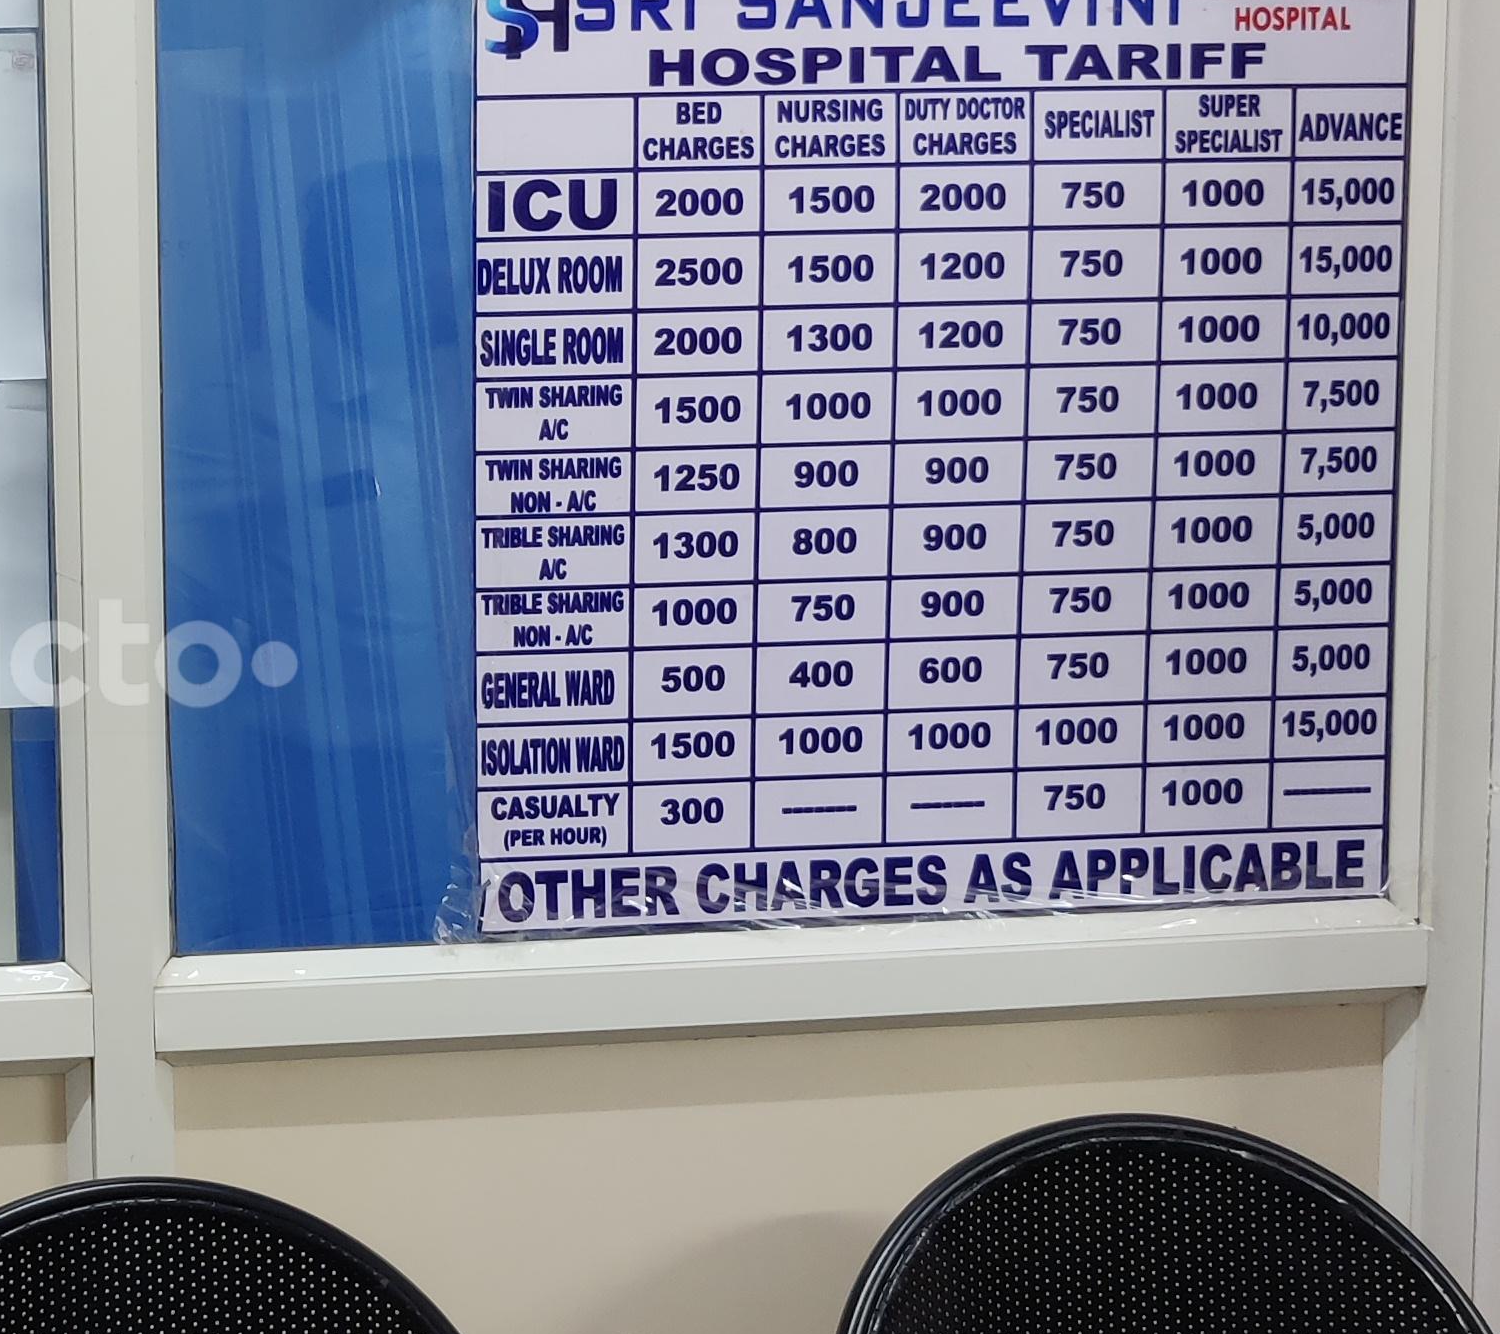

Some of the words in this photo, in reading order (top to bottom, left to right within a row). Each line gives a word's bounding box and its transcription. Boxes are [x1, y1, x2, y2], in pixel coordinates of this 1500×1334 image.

[1235, 7, 1350, 31] HOSPITAL
[649, 46, 1001, 86] HOSPITAL
[1025, 43, 1266, 81] TARIFF
[677, 102, 721, 124] BED
[778, 99, 882, 123] NURSING
[905, 98, 951, 121] DUTY
[957, 97, 1025, 120] DOCTOR
[1199, 94, 1260, 117] SUPER
[1045, 110, 1155, 139] SPECIALIST
[1299, 113, 1402, 141] ADVANCE
[643, 136, 754, 161] CHARGES
[775, 134, 885, 158] CHARGES
[913, 132, 1016, 155] CHARGES
[1175, 129, 1283, 153] SPECIALIST
[488, 179, 617, 232] ICU
[656, 188, 743, 216] 2000
[789, 185, 874, 213] 1500
[920, 183, 1006, 211] 2000
[1062, 181, 1124, 208] 750
[1183, 179, 1264, 207] 1000
[1302, 177, 1394, 211] 15,000
[477, 257, 550, 296] DELUX
[558, 256, 622, 294] ROOM
[655, 257, 742, 286] 2500
[788, 255, 874, 283] 1500
[921, 252, 1005, 280] 1200
[1061, 250, 1123, 277] 750
[1181, 247, 1262, 275] 1000
[1300, 245, 1392, 279] 15,000
[480, 329, 556, 367] SINGLE
[563, 327, 623, 364] ROOM
[481, 671, 561, 709] GENERAL
[565, 670, 614, 706] WARD
[662, 665, 725, 692] 500
[789, 661, 853, 687] 400
[920, 656, 982, 684] 600
[1047, 652, 1109, 679] 750
[1166, 647, 1247, 675] 1000
[1292, 644, 1370, 677] 5,000
[491, 793, 619, 820] CASUALTY
[504, 829, 545, 851] (PER
[551, 826, 606, 847] HOUR)
[498, 866, 680, 922] OTHER
[696, 855, 948, 916] CHARGES
[964, 852, 1032, 903] AS
[1049, 839, 1365, 901] APPLICABLE
